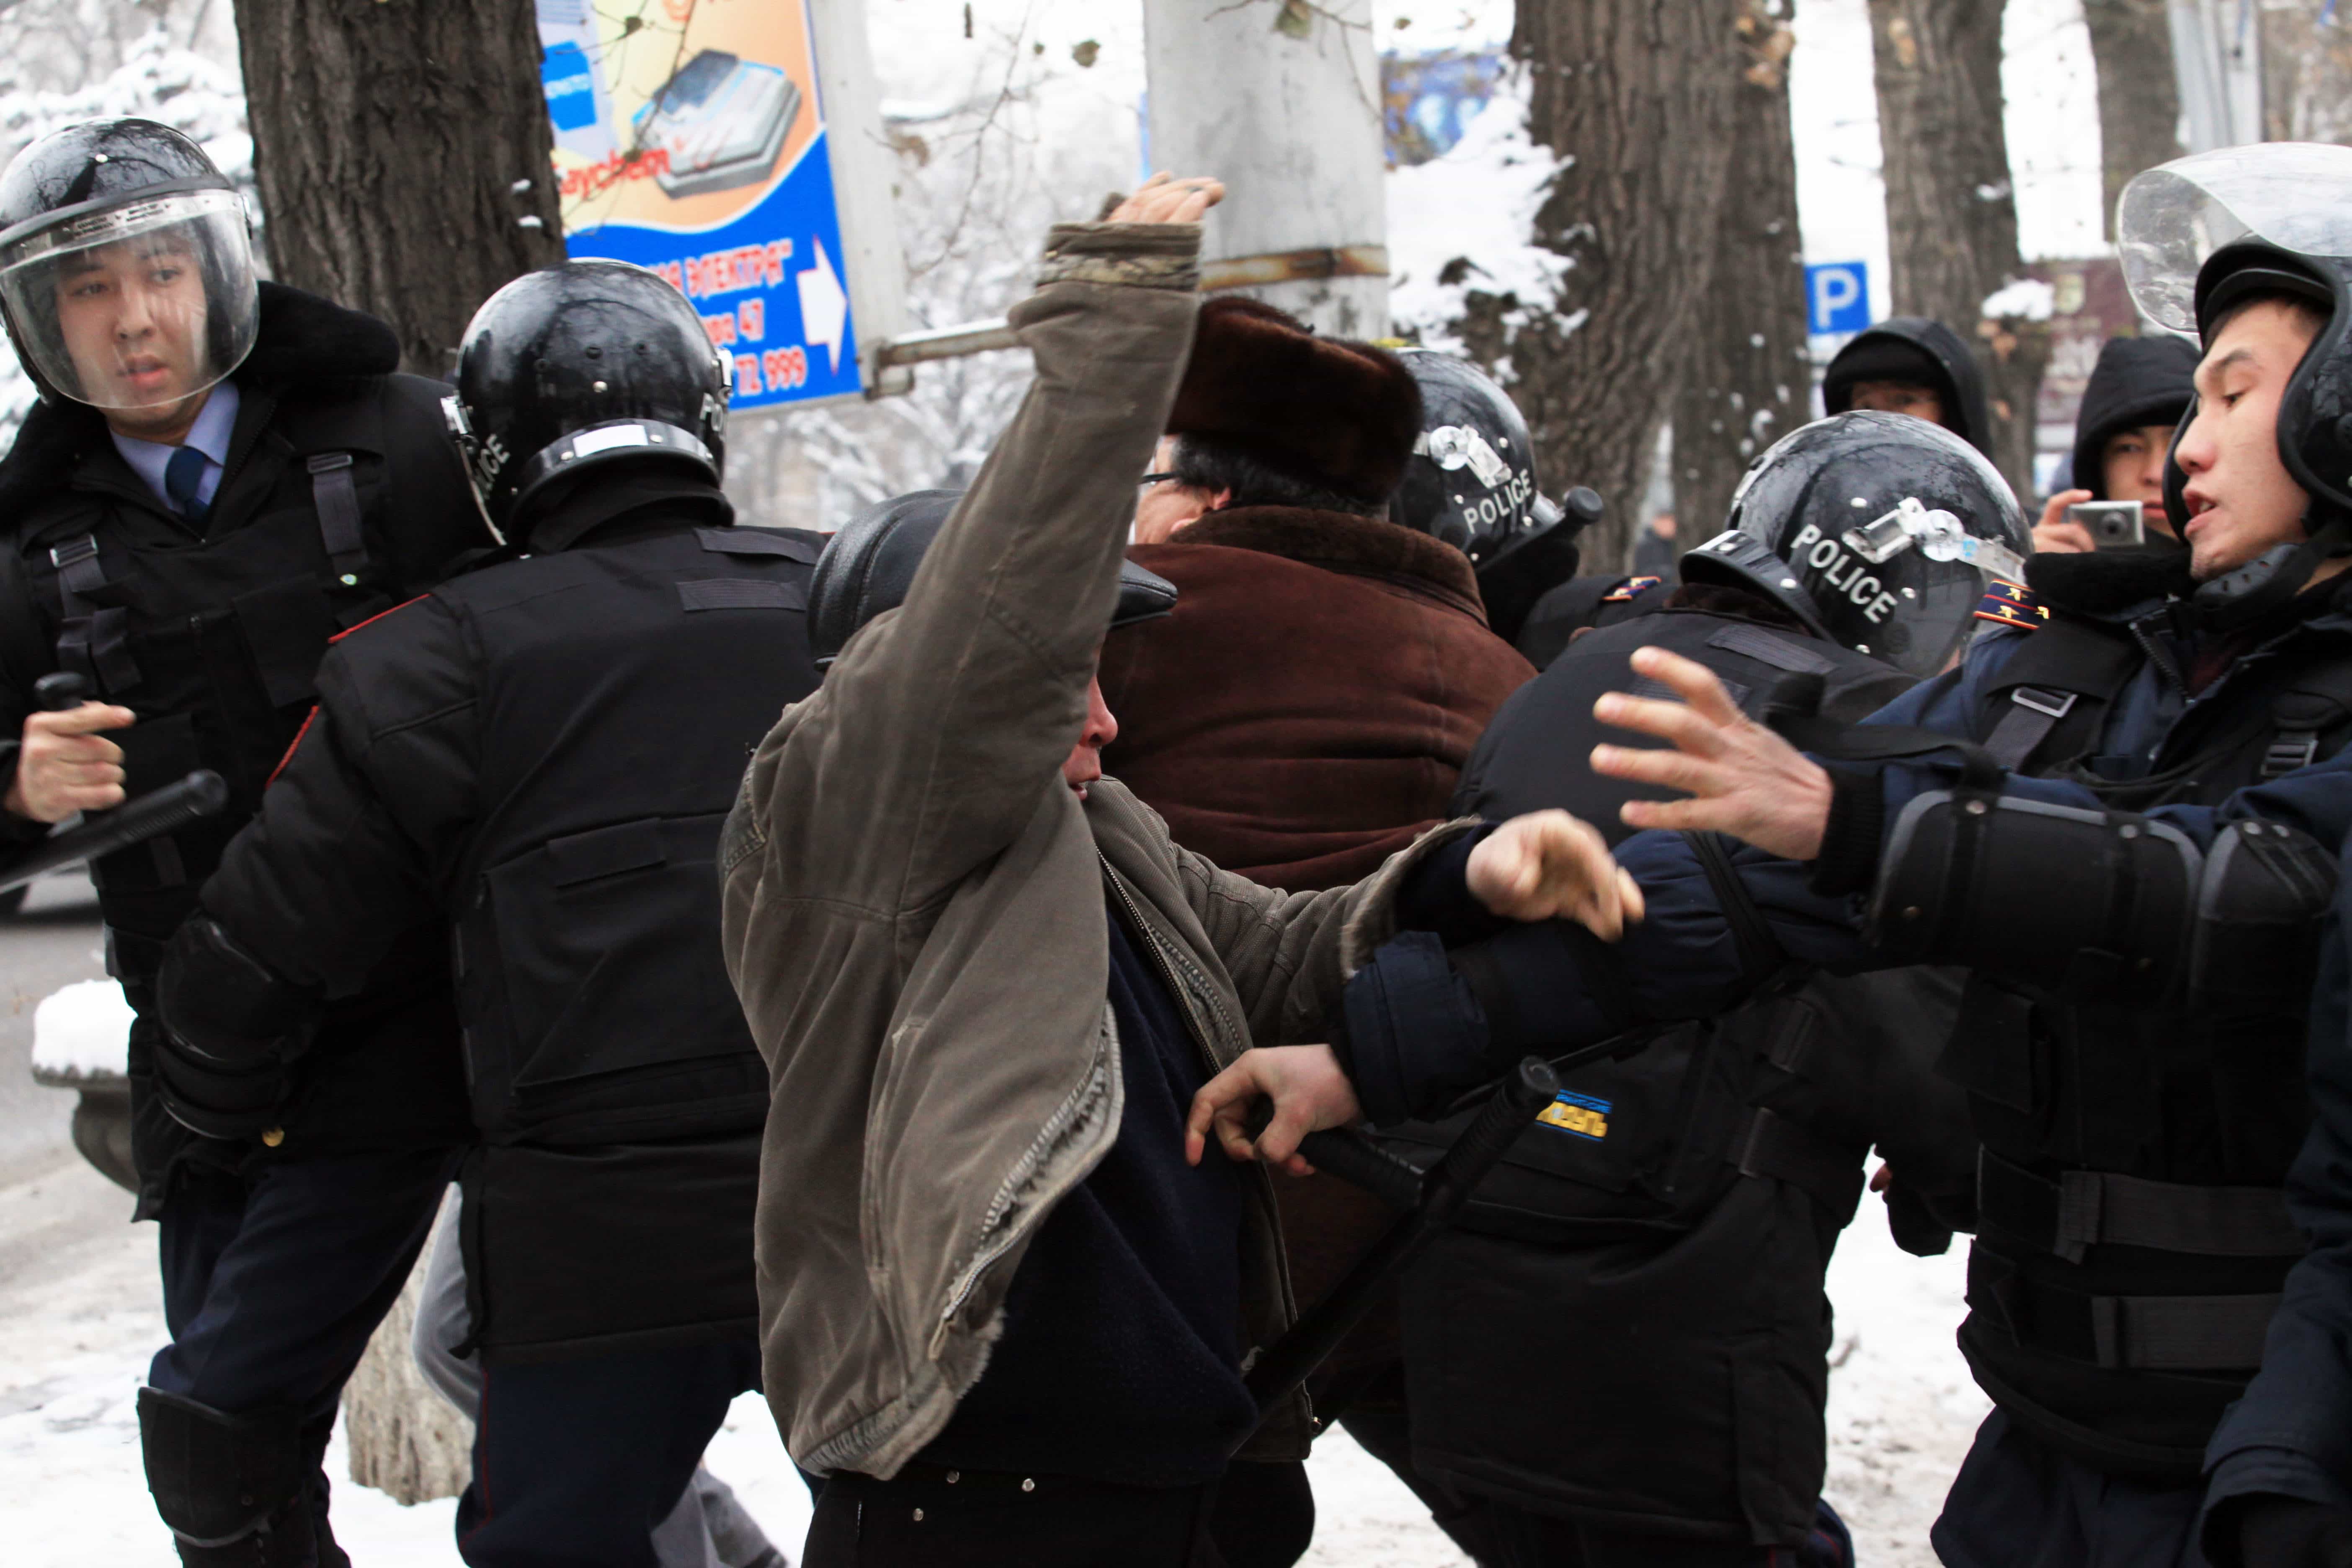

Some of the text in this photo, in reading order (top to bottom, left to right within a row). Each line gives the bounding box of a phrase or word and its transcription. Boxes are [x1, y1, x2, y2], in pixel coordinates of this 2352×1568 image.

[551, 148, 670, 201] aychem
[1816, 268, 1859, 328] P
[763, 346, 807, 392] 999
[1463, 468, 1533, 534] POLICE
[1790, 524, 1898, 624] POLICE
